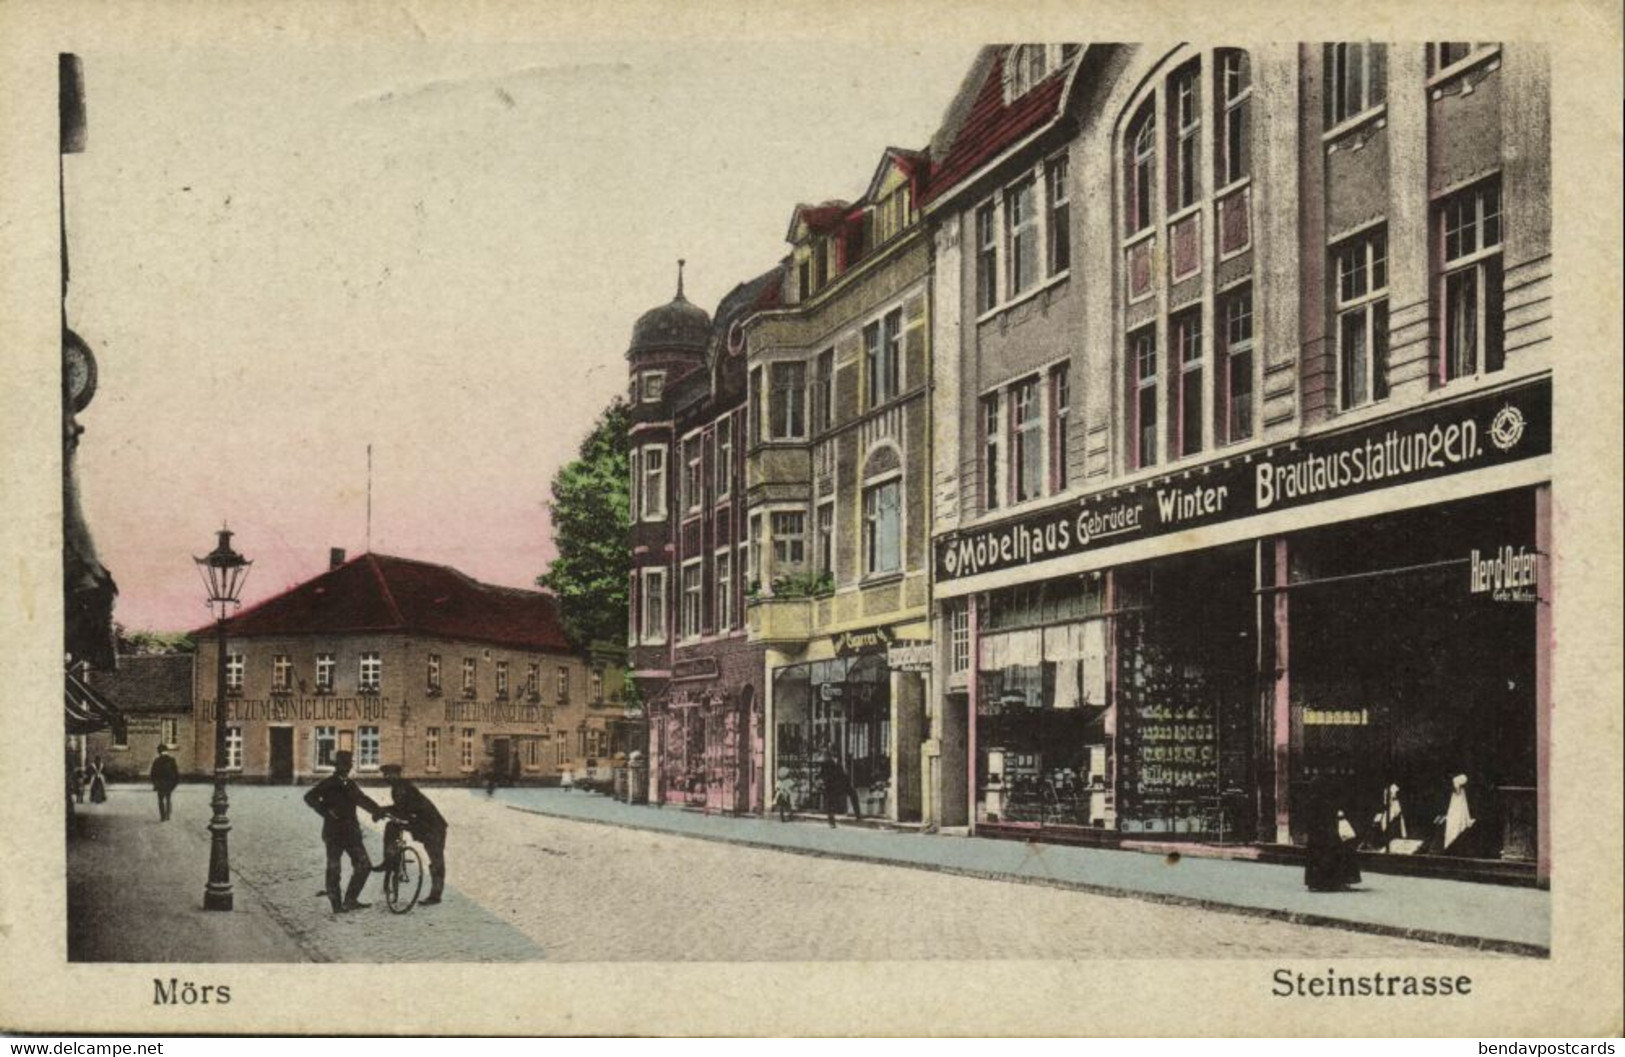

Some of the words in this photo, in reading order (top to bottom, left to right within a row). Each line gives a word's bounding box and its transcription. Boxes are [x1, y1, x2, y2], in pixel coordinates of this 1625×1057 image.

[954, 519, 1069, 578] Möbelhaus
[1077, 503, 1143, 545] Gebrüder
[1157, 485, 1229, 524] Winter
[1256, 419, 1483, 509] Brautausstattungen.
[202, 698, 244, 722] HOEL
[362, 696, 390, 722] HOF
